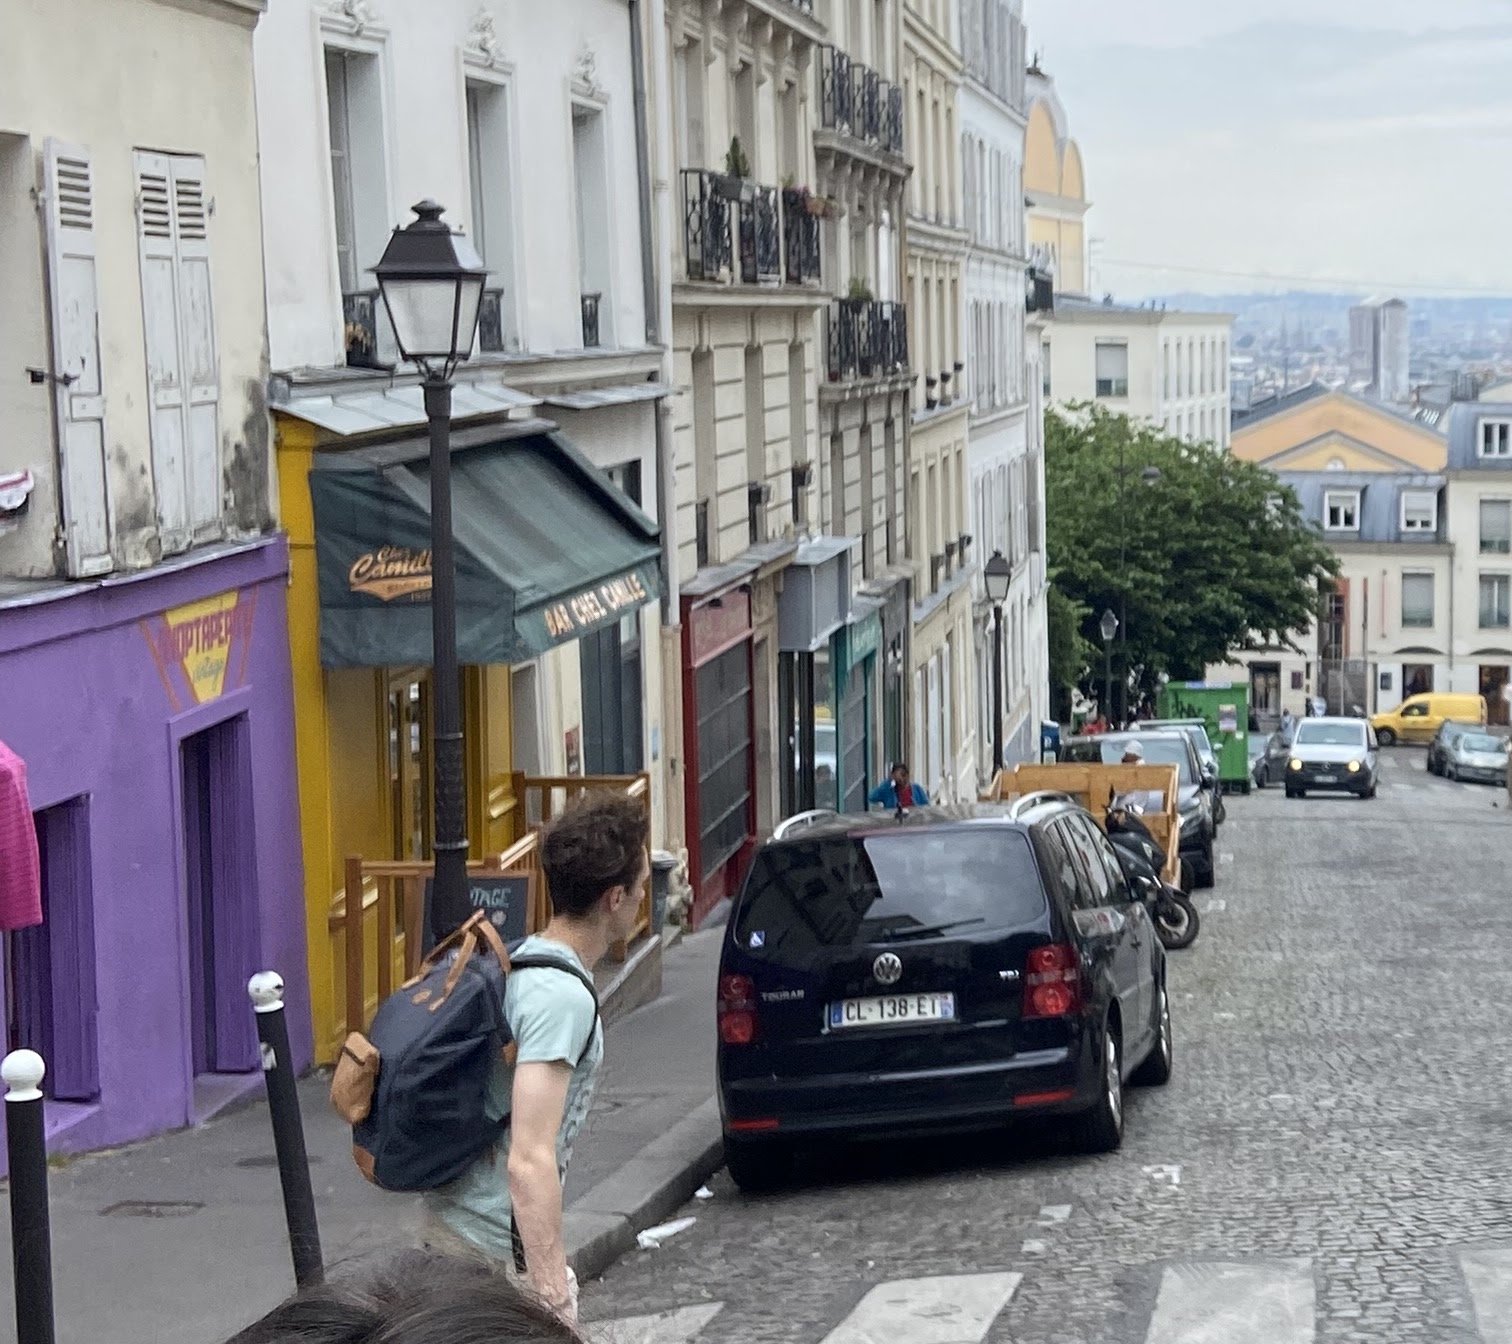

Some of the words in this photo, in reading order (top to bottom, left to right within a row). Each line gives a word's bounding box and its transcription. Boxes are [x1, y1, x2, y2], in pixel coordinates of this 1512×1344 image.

[349, 548, 432, 588] Camill
[544, 603, 575, 637] BAR
[571, 590, 608, 625] CHEZ
